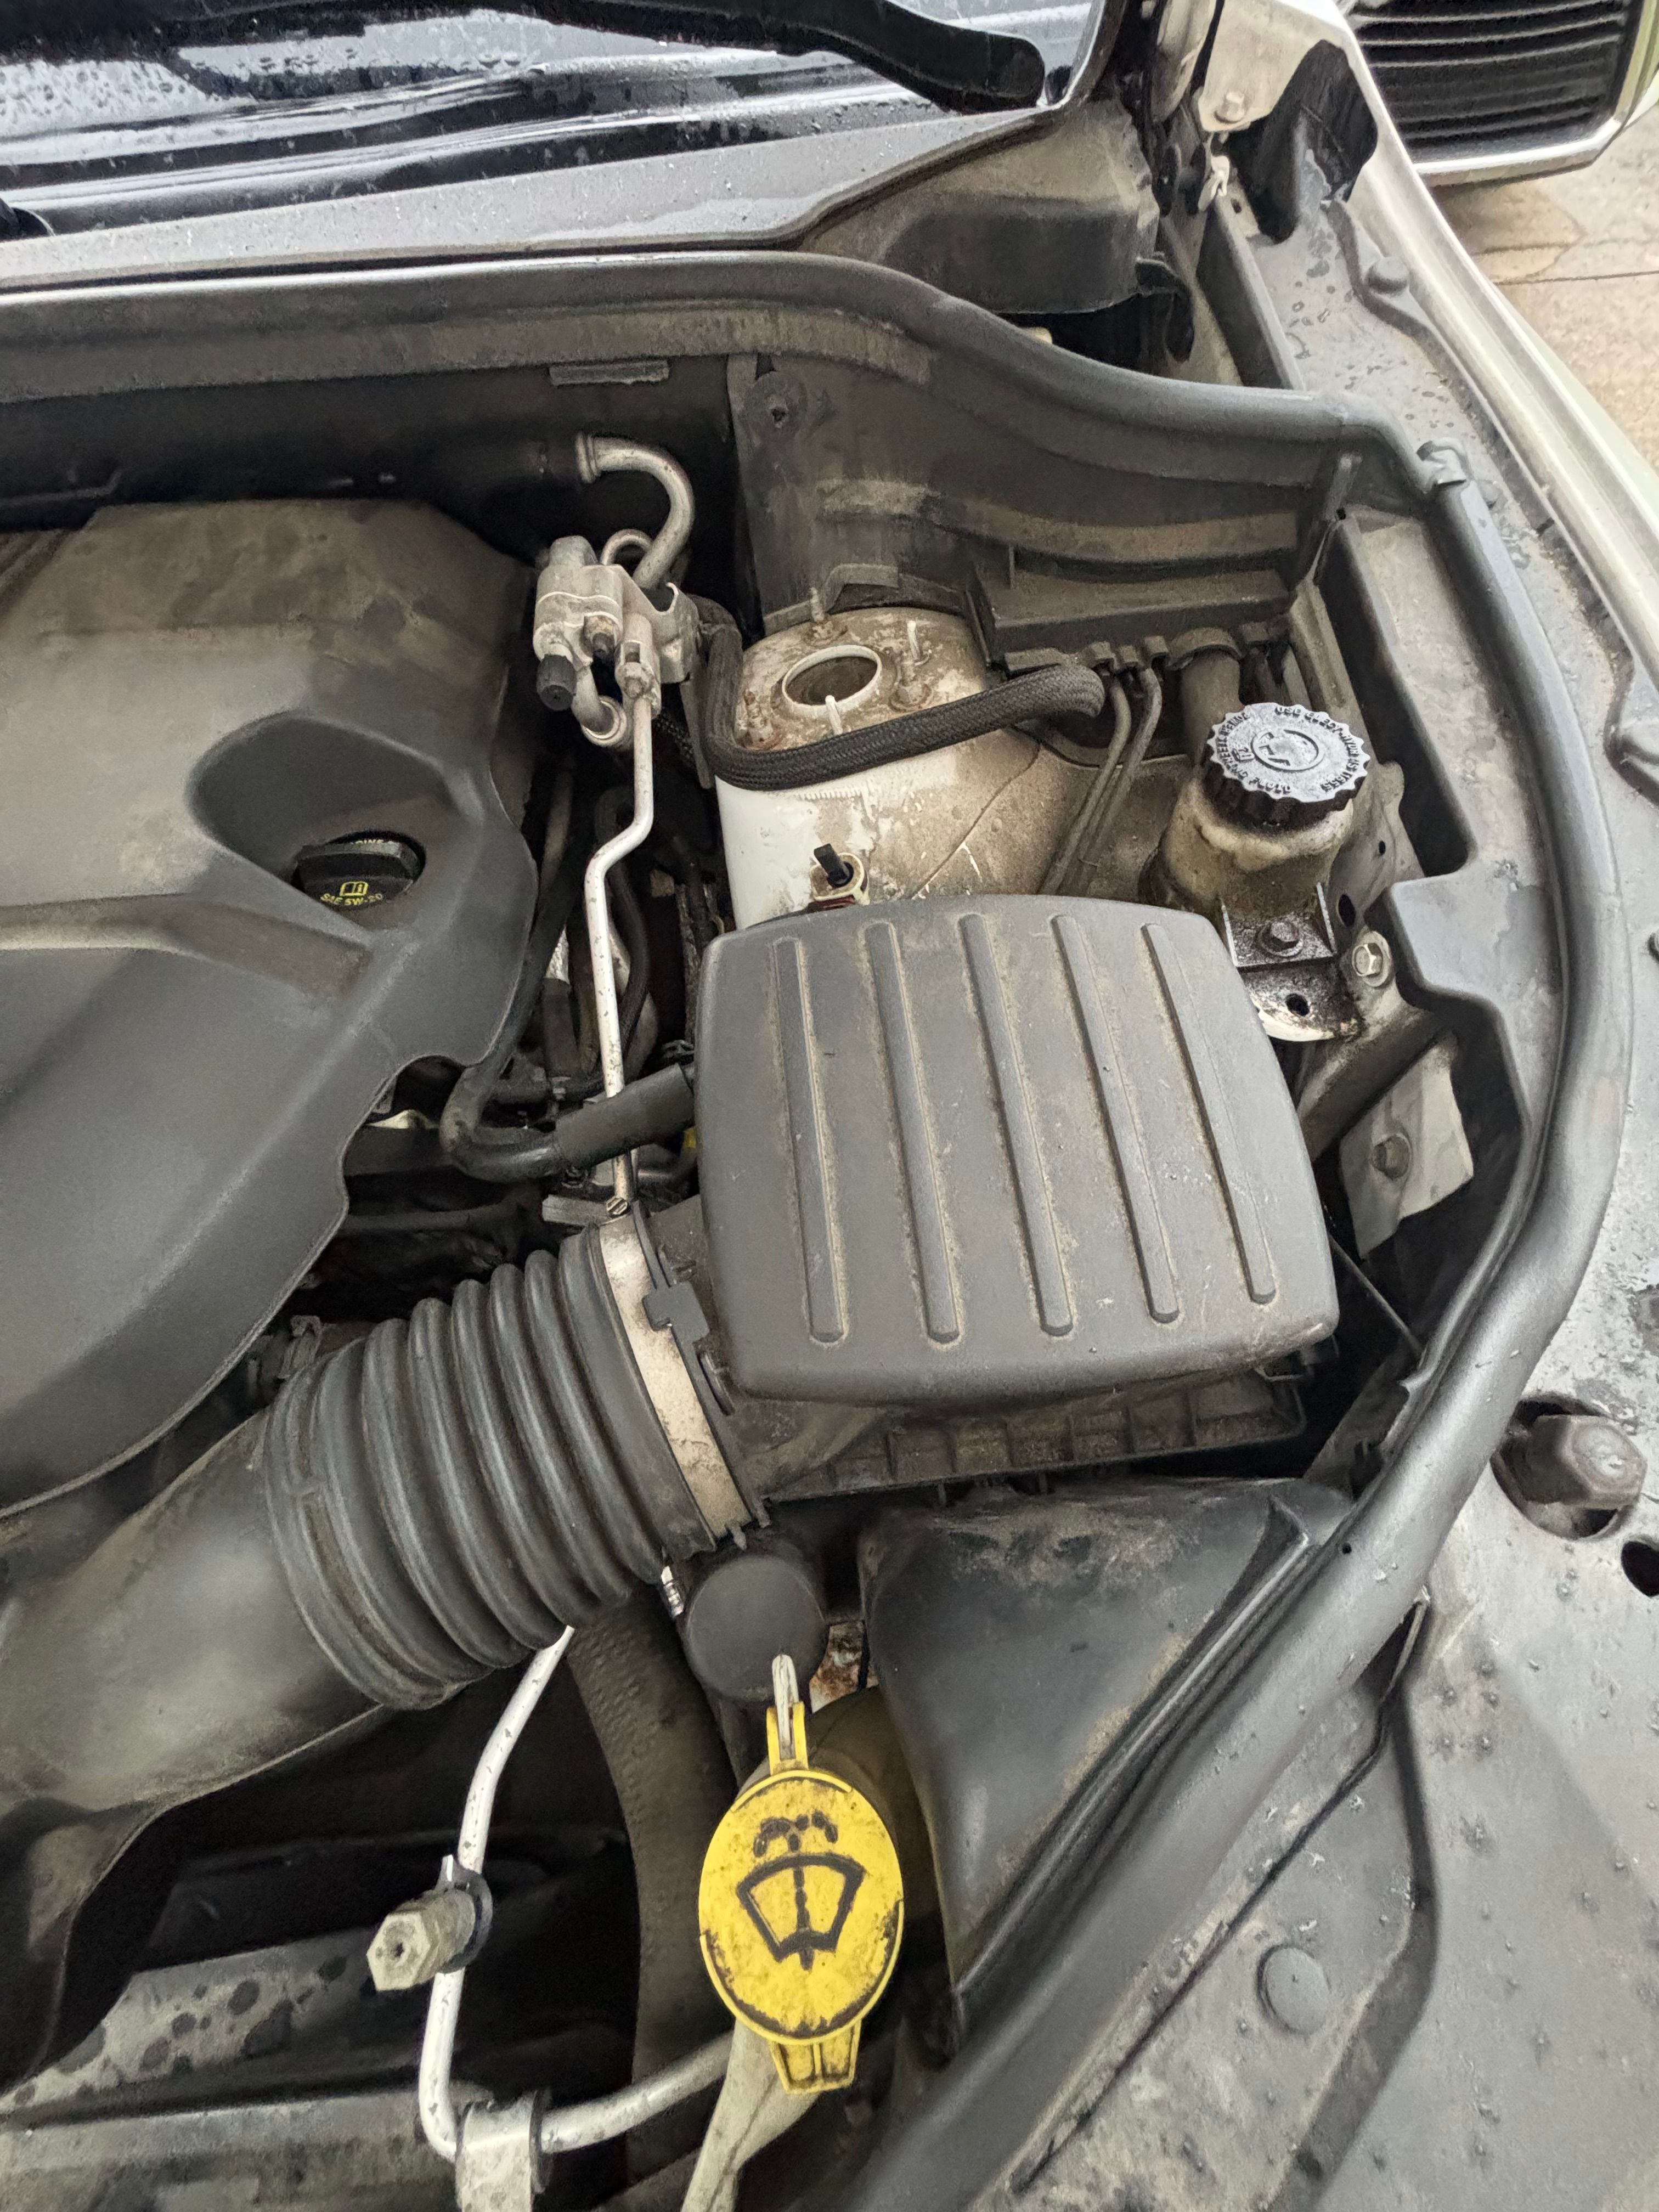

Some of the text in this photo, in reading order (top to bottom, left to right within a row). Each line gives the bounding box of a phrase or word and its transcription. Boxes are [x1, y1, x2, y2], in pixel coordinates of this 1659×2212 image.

[1219, 712, 1251, 736] POWER
[1215, 736, 1249, 780] STEERING
[320, 893, 383, 906] SAE 5W-20
